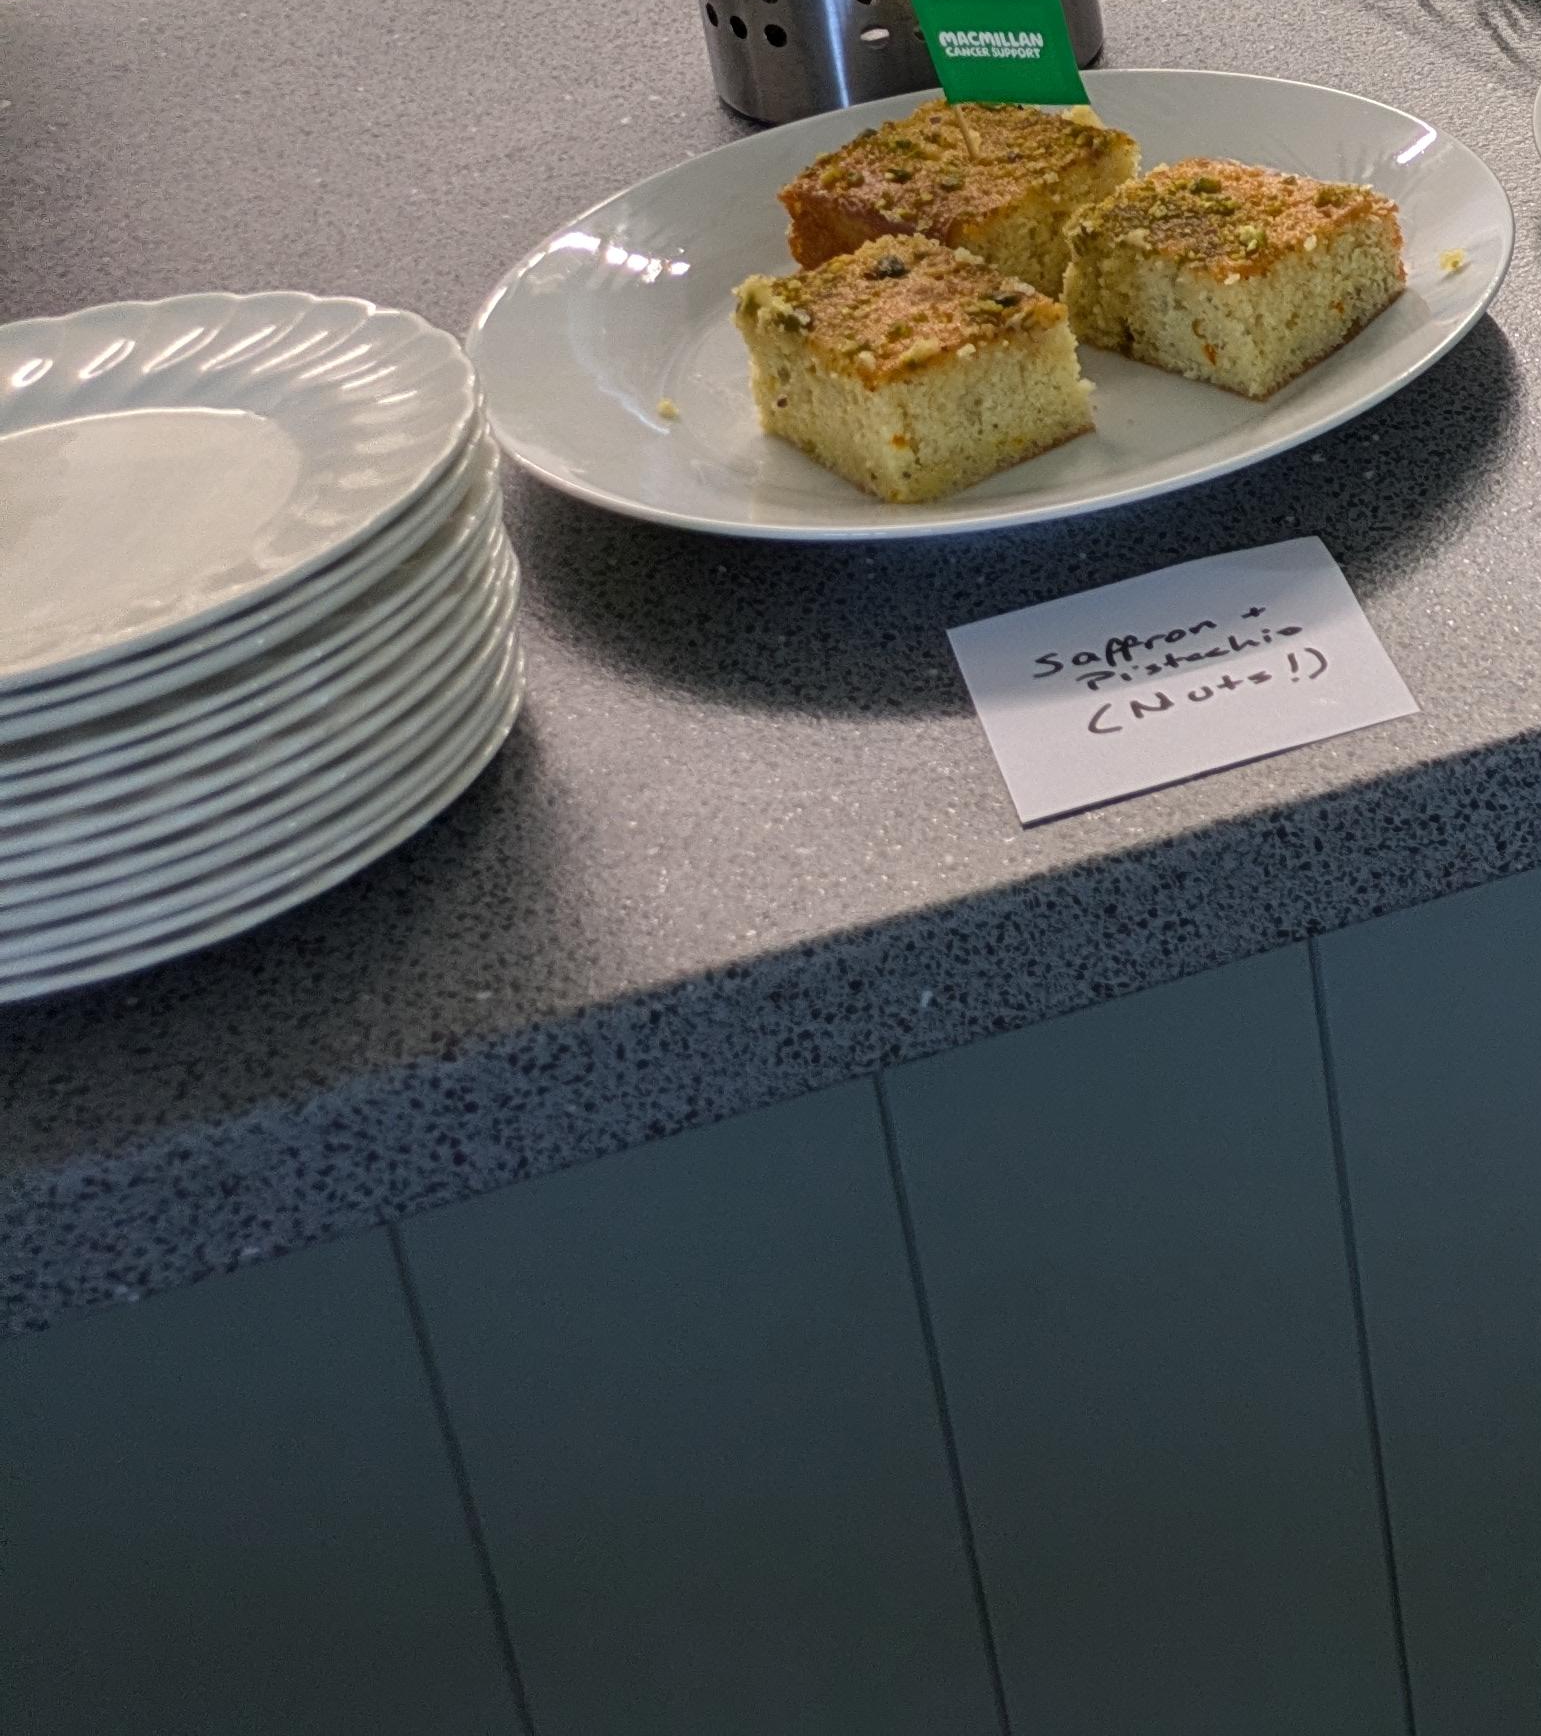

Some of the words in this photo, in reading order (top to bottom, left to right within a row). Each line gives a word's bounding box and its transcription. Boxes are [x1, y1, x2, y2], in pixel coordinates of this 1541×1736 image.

[939, 30, 1044, 47] MACMILLAN
[945, 46, 991, 58] CANCER
[991, 47, 1041, 59] SUPPORT
[1033, 619, 1218, 679] Saffron
[1240, 605, 1267, 620] +
[1075, 625, 1304, 692] Pistachio
